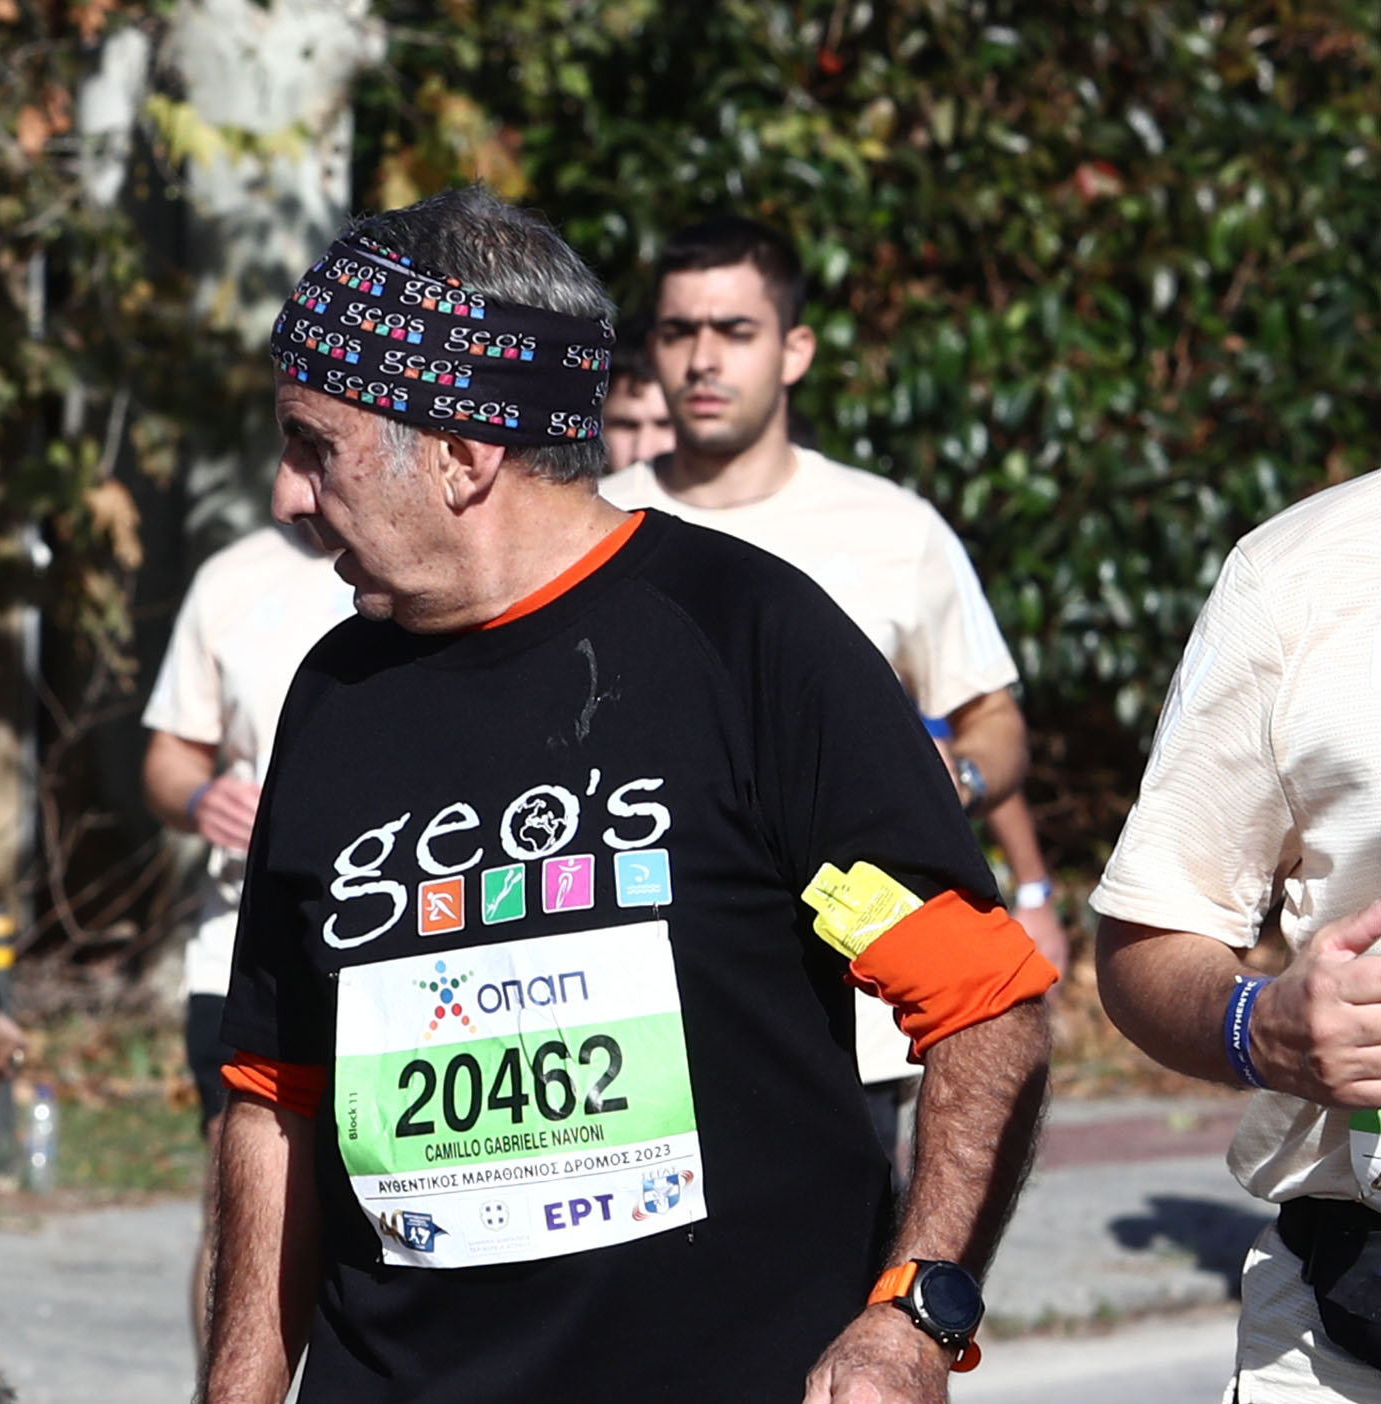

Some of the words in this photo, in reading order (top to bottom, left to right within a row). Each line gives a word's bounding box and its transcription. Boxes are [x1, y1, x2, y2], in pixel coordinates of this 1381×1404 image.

[340, 302, 425, 333] geo's
[290, 319, 362, 353] geo's
[444, 326, 537, 352] geo's
[379, 350, 472, 378] geo's
[323, 370, 409, 402] geo's
[429, 395, 520, 419] geo's
[322, 768, 672, 950] geo's
[1233, 981, 1257, 1050] AUTHENTIC
[395, 1034, 629, 1139] 20462
[348, 1104, 359, 1140] Block
[425, 1139, 482, 1163] CAMILLO
[484, 1130, 548, 1155] GABRIELE
[551, 1124, 605, 1147] NAVONI
[378, 1174, 460, 1194] ΑΥΘΕΝΤΙΚΟΣ
[462, 1162, 559, 1184] ΜΑΡΑΘΩΝΙΟΣ
[563, 1150, 632, 1174] ΔΡΟΜΟΣ
[634, 1143, 672, 1162] 2023
[544, 1193, 615, 1231] ΕΡΤ
